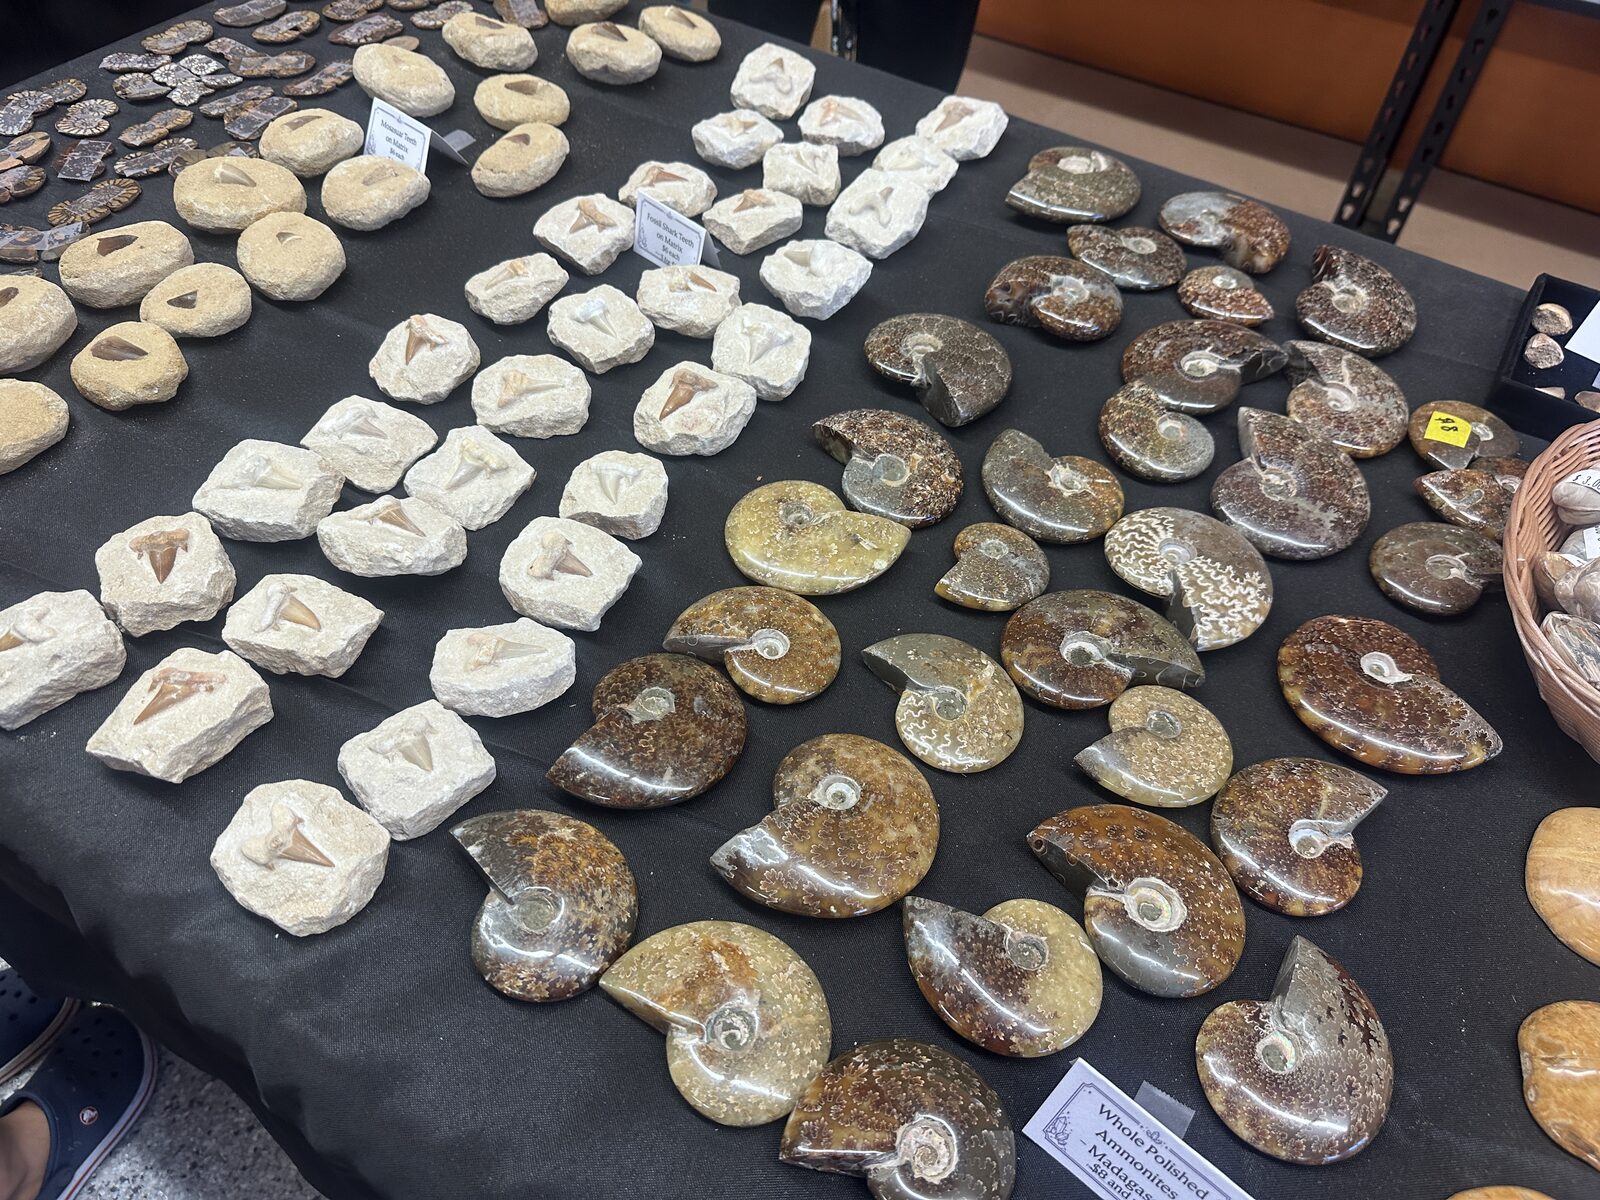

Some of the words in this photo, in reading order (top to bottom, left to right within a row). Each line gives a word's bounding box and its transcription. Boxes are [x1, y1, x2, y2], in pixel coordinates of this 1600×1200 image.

[392, 139, 408, 154] Matrix
[404, 132, 417, 146] Teeth
[647, 212, 662, 228] Fossil
[662, 222, 678, 239] Shark
[678, 232, 694, 248] Teeth
[656, 233, 665, 241] on
[664, 235, 683, 254] Matrix
[1095, 1129, 1179, 1200] Ammonites
[1098, 1103, 1145, 1147] Whole
[1145, 1144, 1209, 1199] Polished
[1088, 1144, 1154, 1200] Madagas
[1107, 1179, 1131, 1199] and
